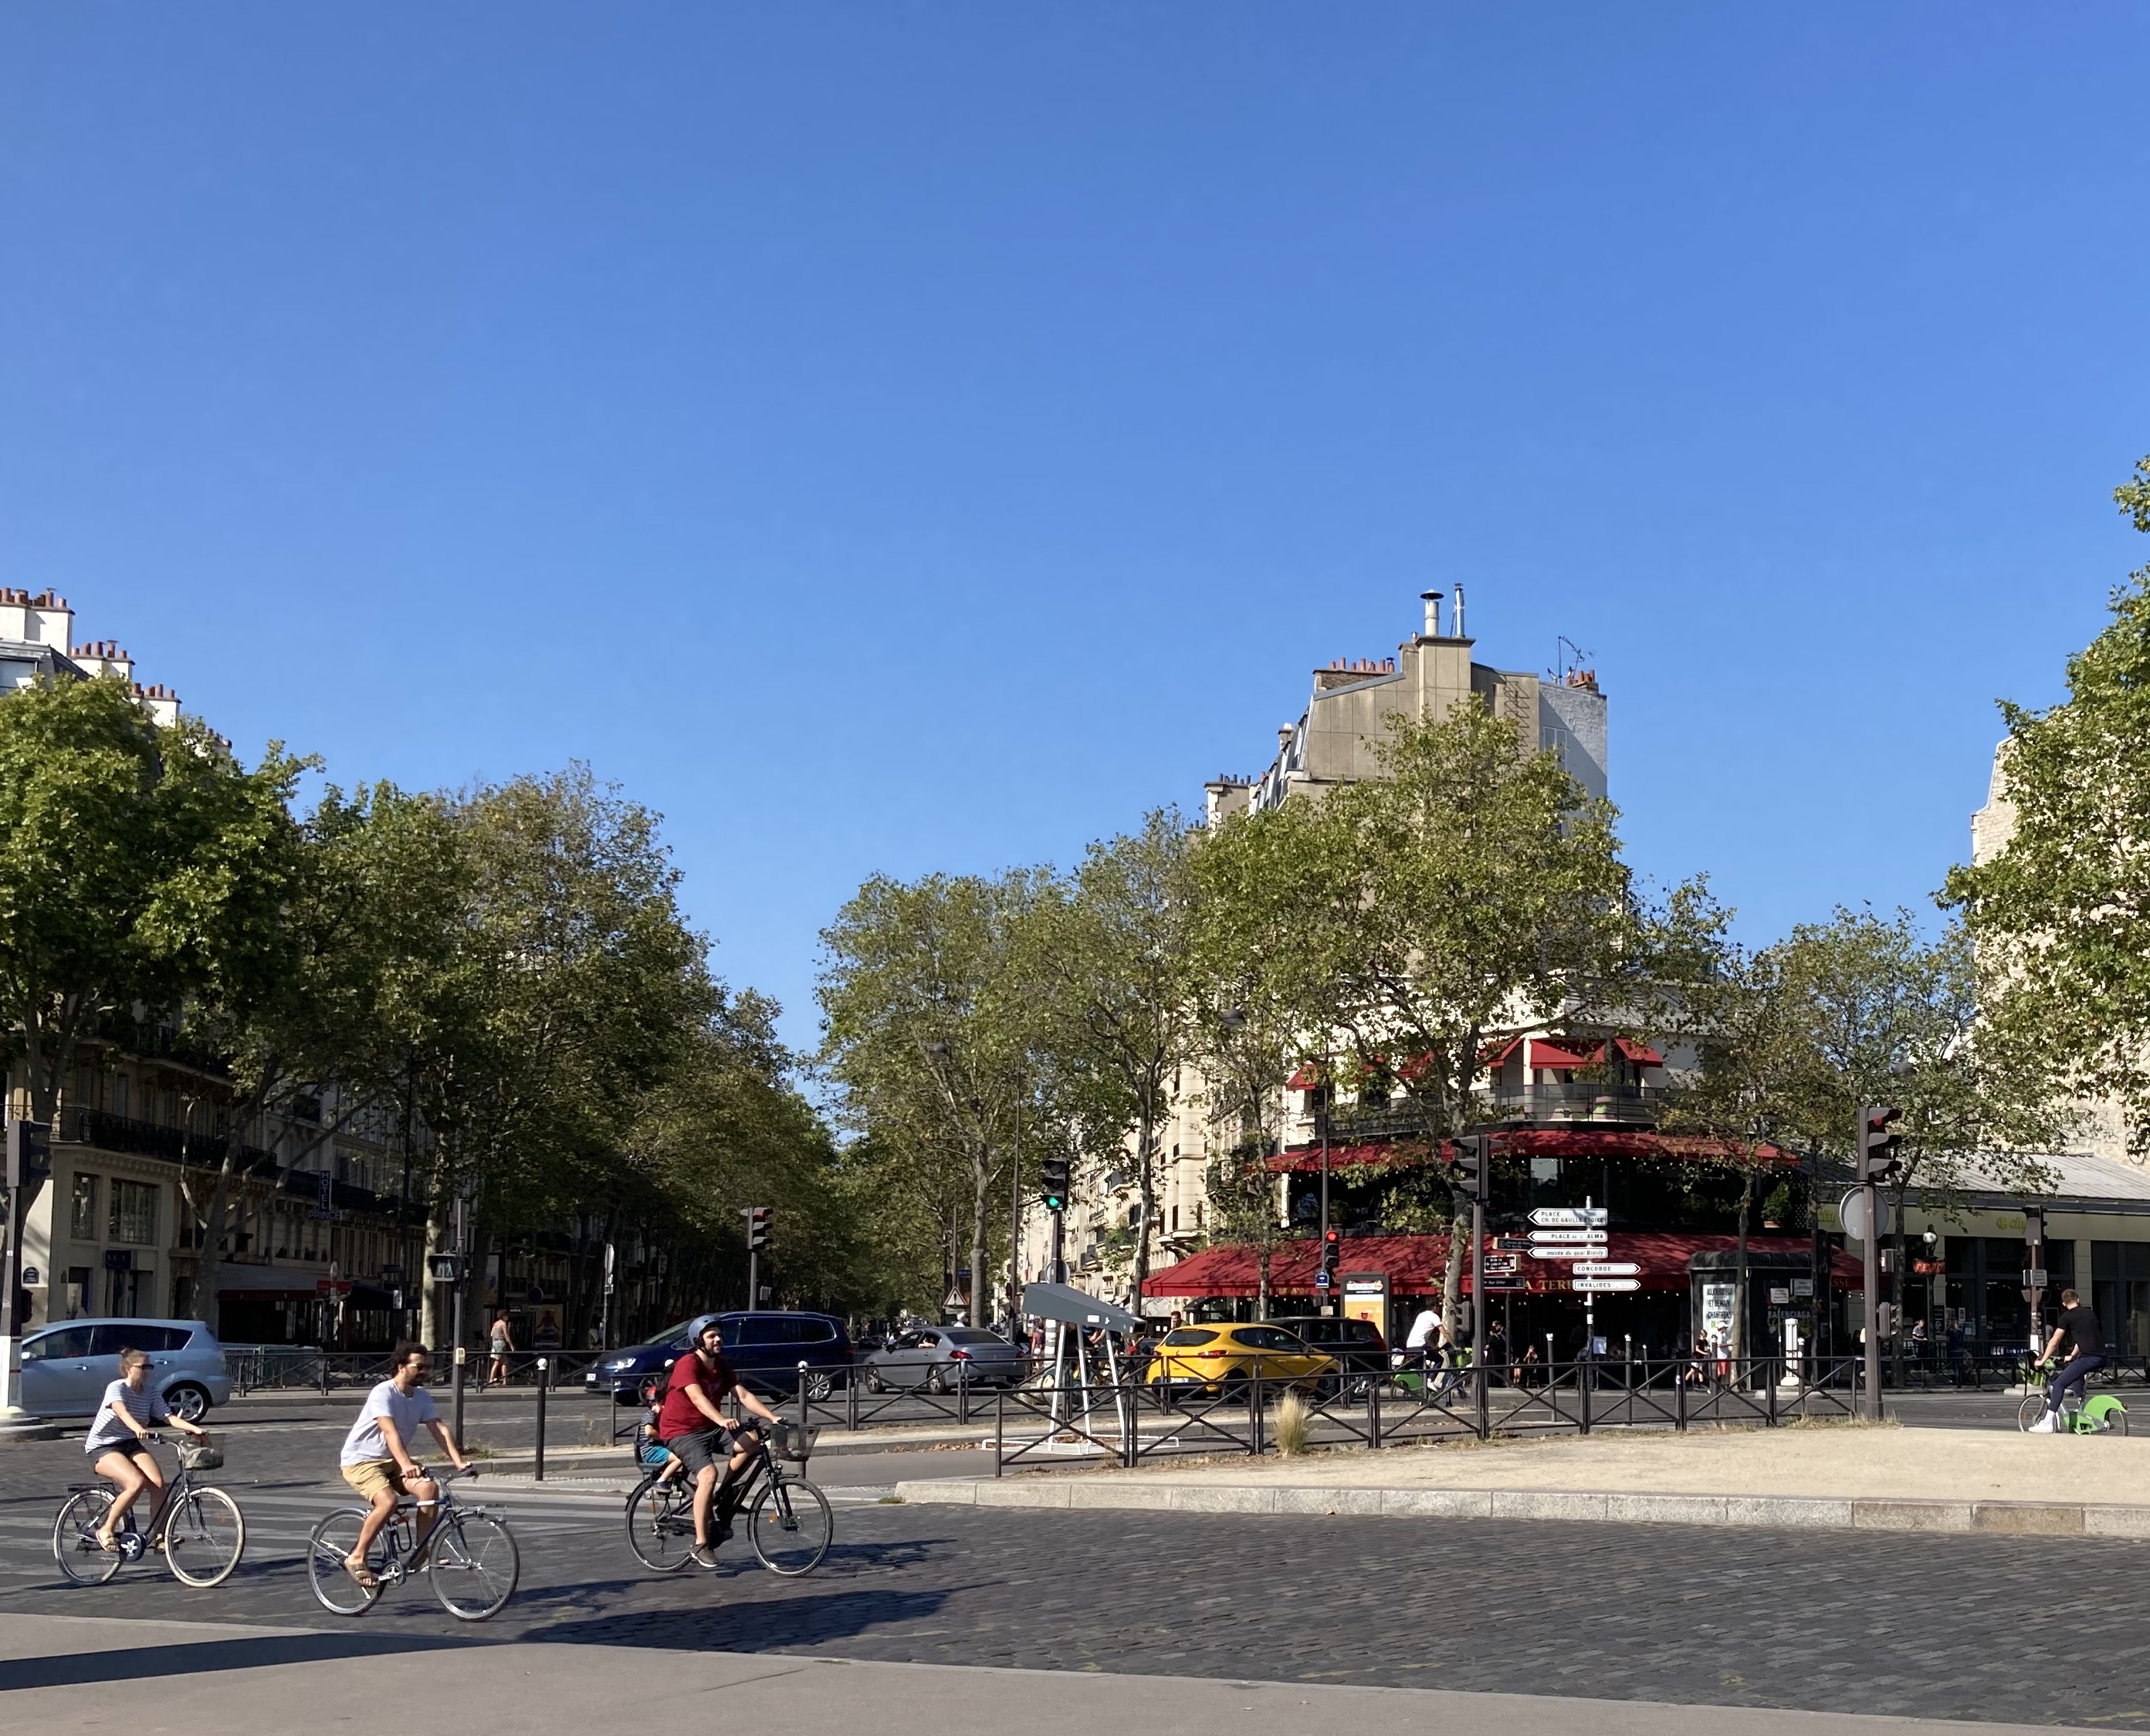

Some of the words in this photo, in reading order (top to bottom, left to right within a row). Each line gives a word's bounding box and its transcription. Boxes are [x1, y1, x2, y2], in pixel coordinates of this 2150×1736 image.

[309, 1211, 340, 1220] PRINCE
[1715, 1299, 1731, 1308] DEMAIN
[1768, 1311, 1811, 1319] BAENCIAGA
